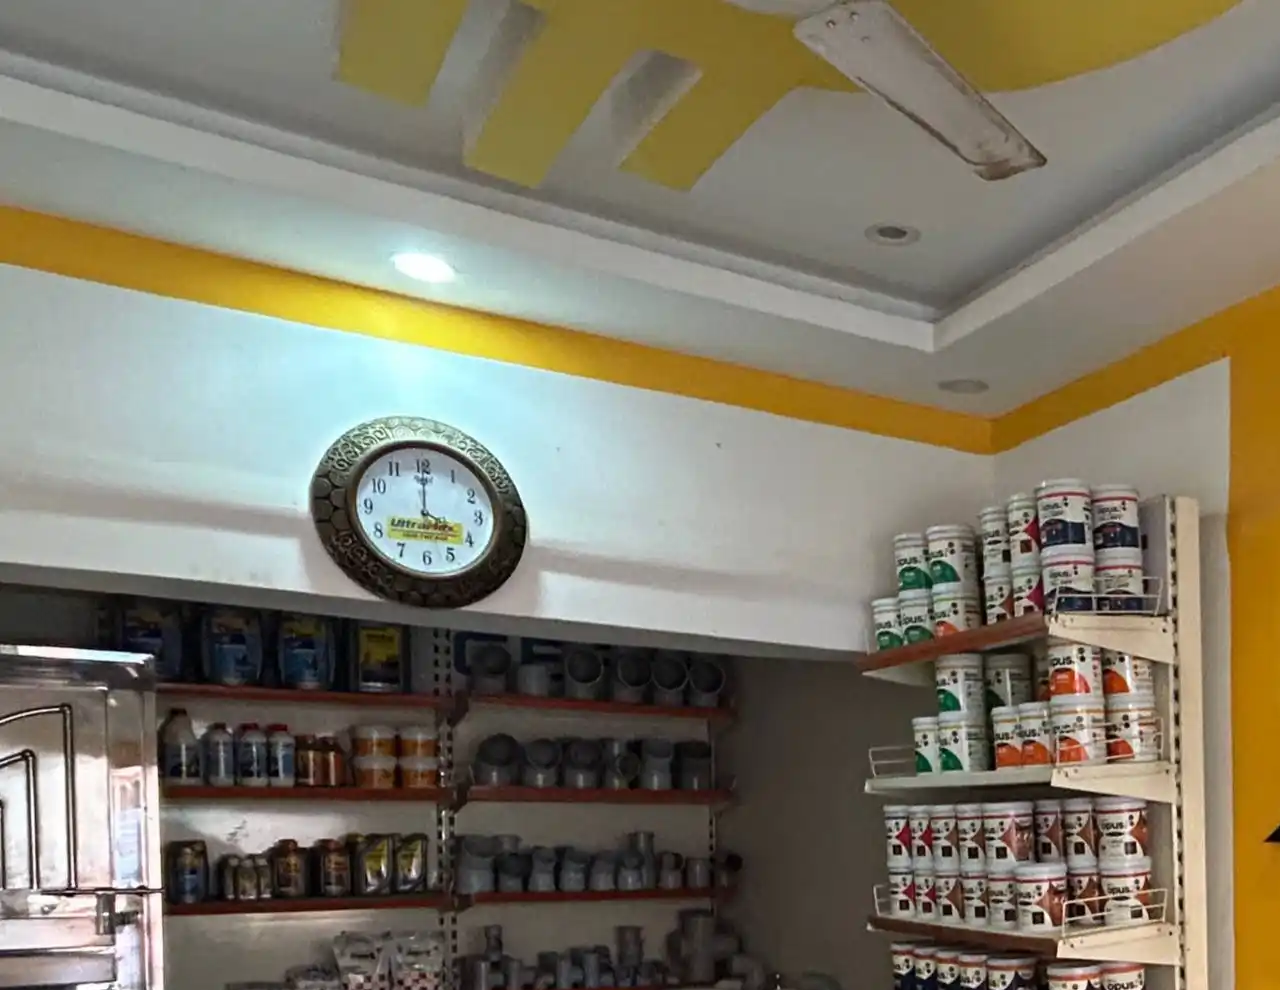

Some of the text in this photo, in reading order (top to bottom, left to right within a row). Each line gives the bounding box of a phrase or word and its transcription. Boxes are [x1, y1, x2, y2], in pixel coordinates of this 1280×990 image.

[388, 461, 399, 476] 11
[416, 459, 430, 475] 12
[450, 469, 455, 484] 1
[372, 478, 386, 494] 10
[466, 488, 475, 504] 2
[364, 498, 373, 514] 9
[474, 510, 483, 526] 3
[373, 522, 383, 539] 8
[465, 530, 474, 547] 4
[397, 541, 405, 558] 7
[423, 550, 432, 565] 6
[446, 546, 455, 562] 5
